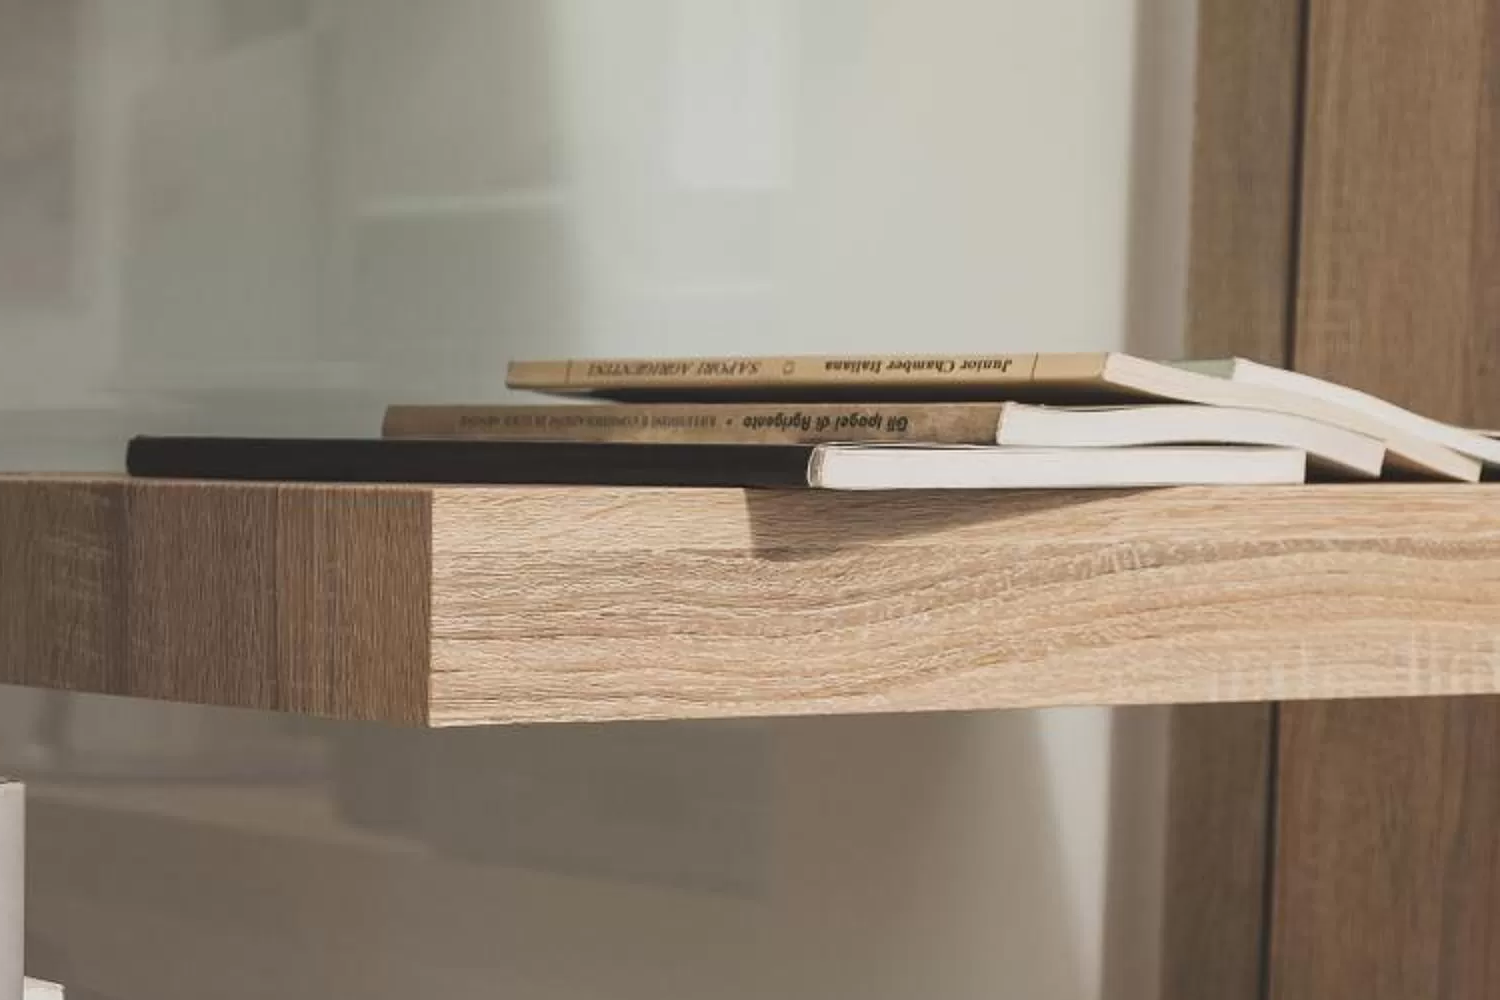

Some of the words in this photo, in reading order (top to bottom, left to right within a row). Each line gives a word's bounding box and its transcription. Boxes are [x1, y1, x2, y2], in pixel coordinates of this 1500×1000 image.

[697, 360, 763, 377] SAPORI
[825, 359, 883, 374] Italiana
[886, 359, 956, 374] Chamber
[960, 359, 1012, 374] Junior
[743, 411, 812, 433] Agrigento
[816, 414, 831, 431] di
[886, 414, 909, 432] Gli
